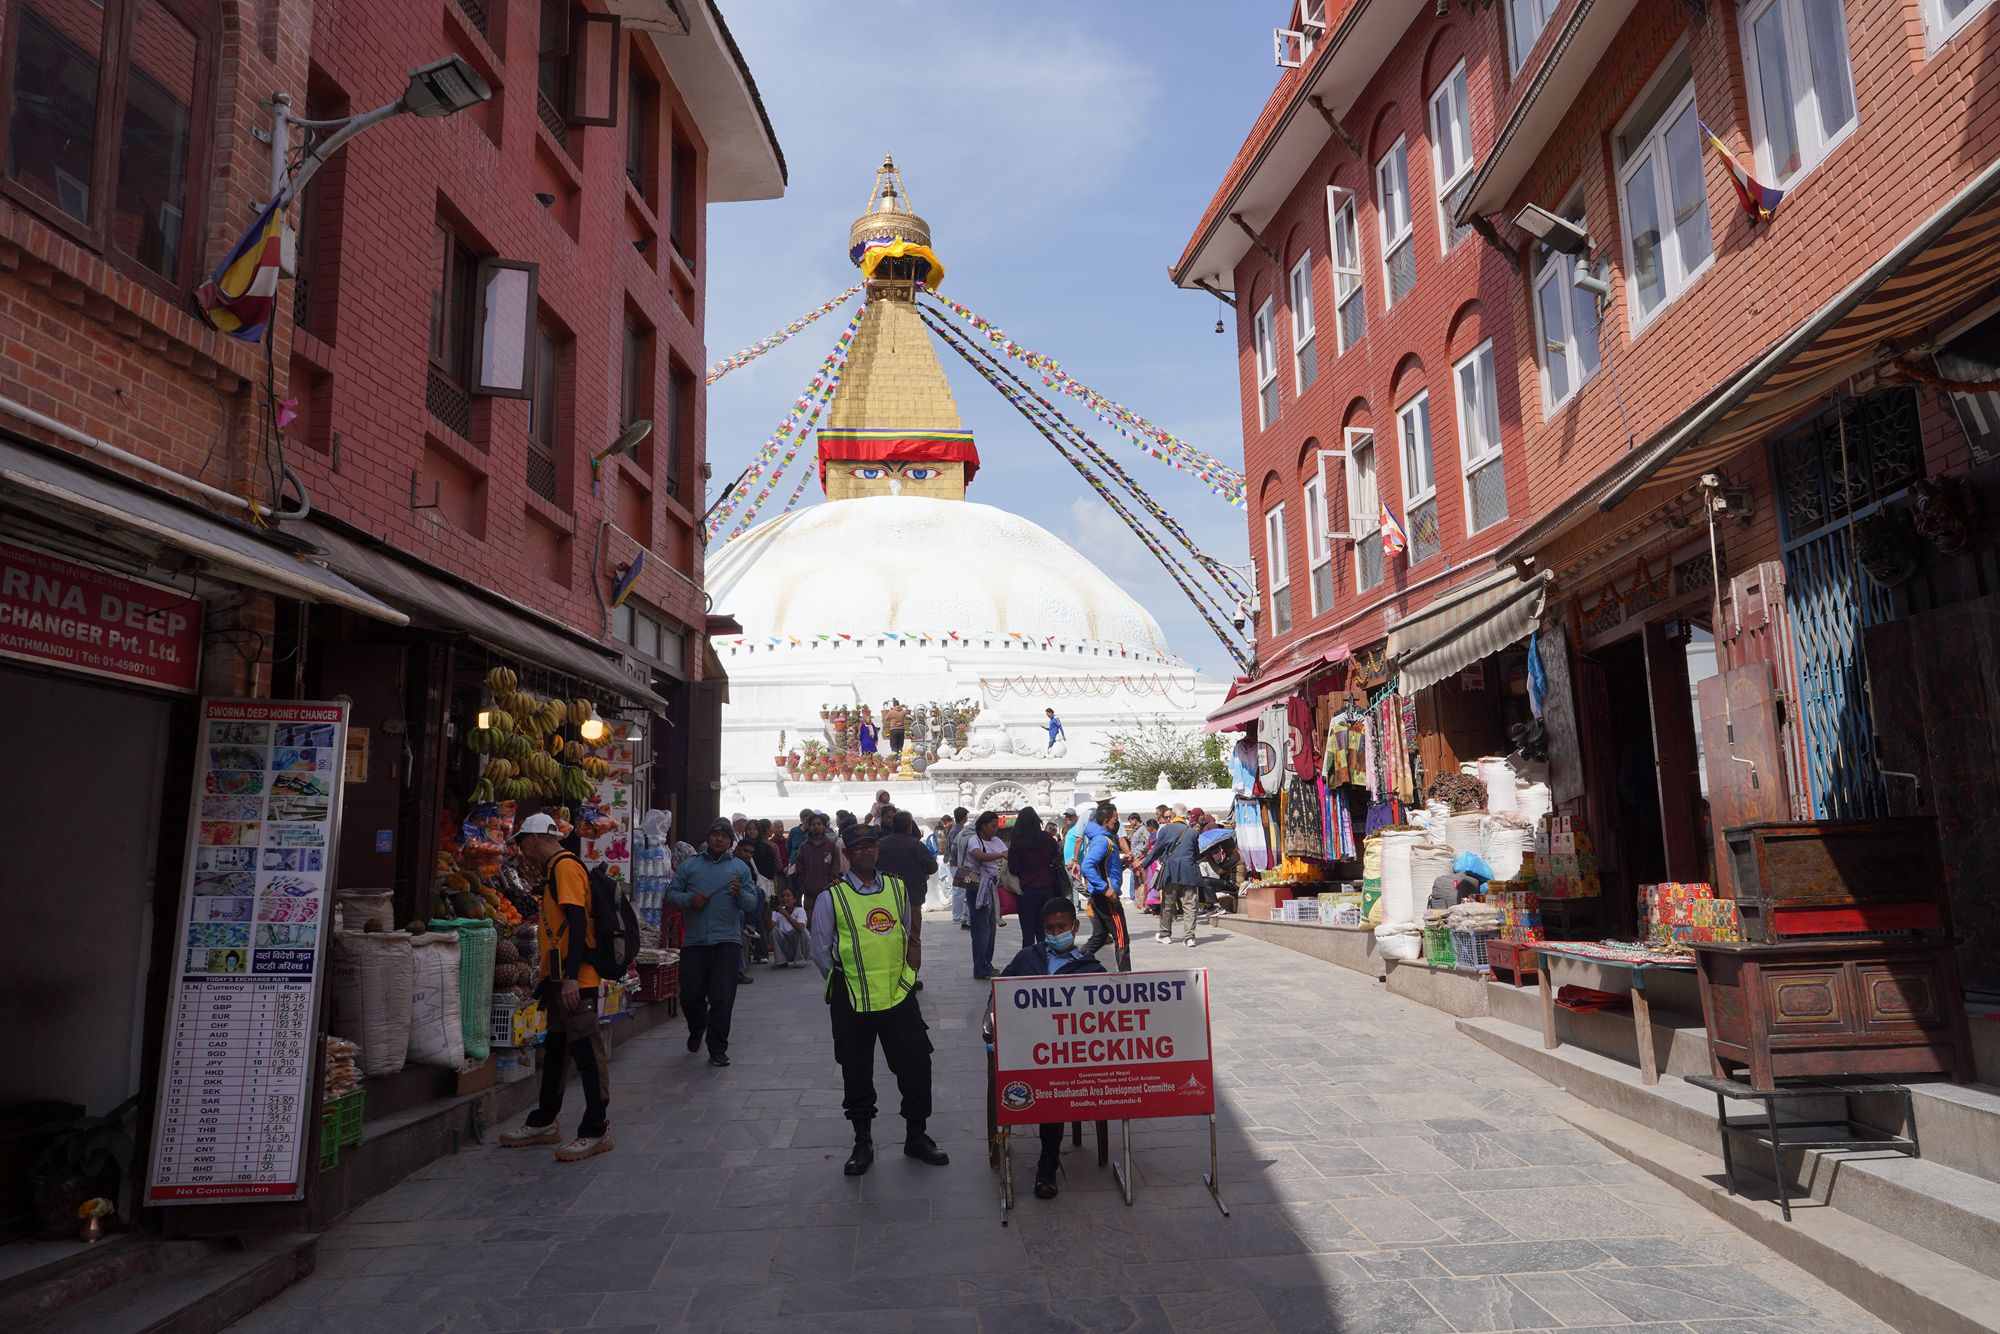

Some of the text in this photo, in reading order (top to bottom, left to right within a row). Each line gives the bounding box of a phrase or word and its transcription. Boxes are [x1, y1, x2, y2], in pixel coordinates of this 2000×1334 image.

[0, 551, 37, 565] orization
[101, 593, 187, 638] DEEP
[0, 603, 180, 663] CHANGER Pvt. Ltd.
[0, 633, 73, 658] KATHMANDU
[82, 651, 100, 664] Tel:
[103, 656, 155, 675] 01-4590710
[209, 707, 338, 720] SWORNA DEEP MONEY CHANGER
[272, 951, 295, 959] विदेशी
[1014, 981, 1185, 1009] ONLY TOURIST
[1052, 1009, 1150, 1035] TICKET
[1033, 1036, 1174, 1065] CHECKING
[1036, 1083, 1175, 1099] Shree Boudhanath Area Development Committee
[1099, 1098, 1142, 1106] Kathmandu-6
